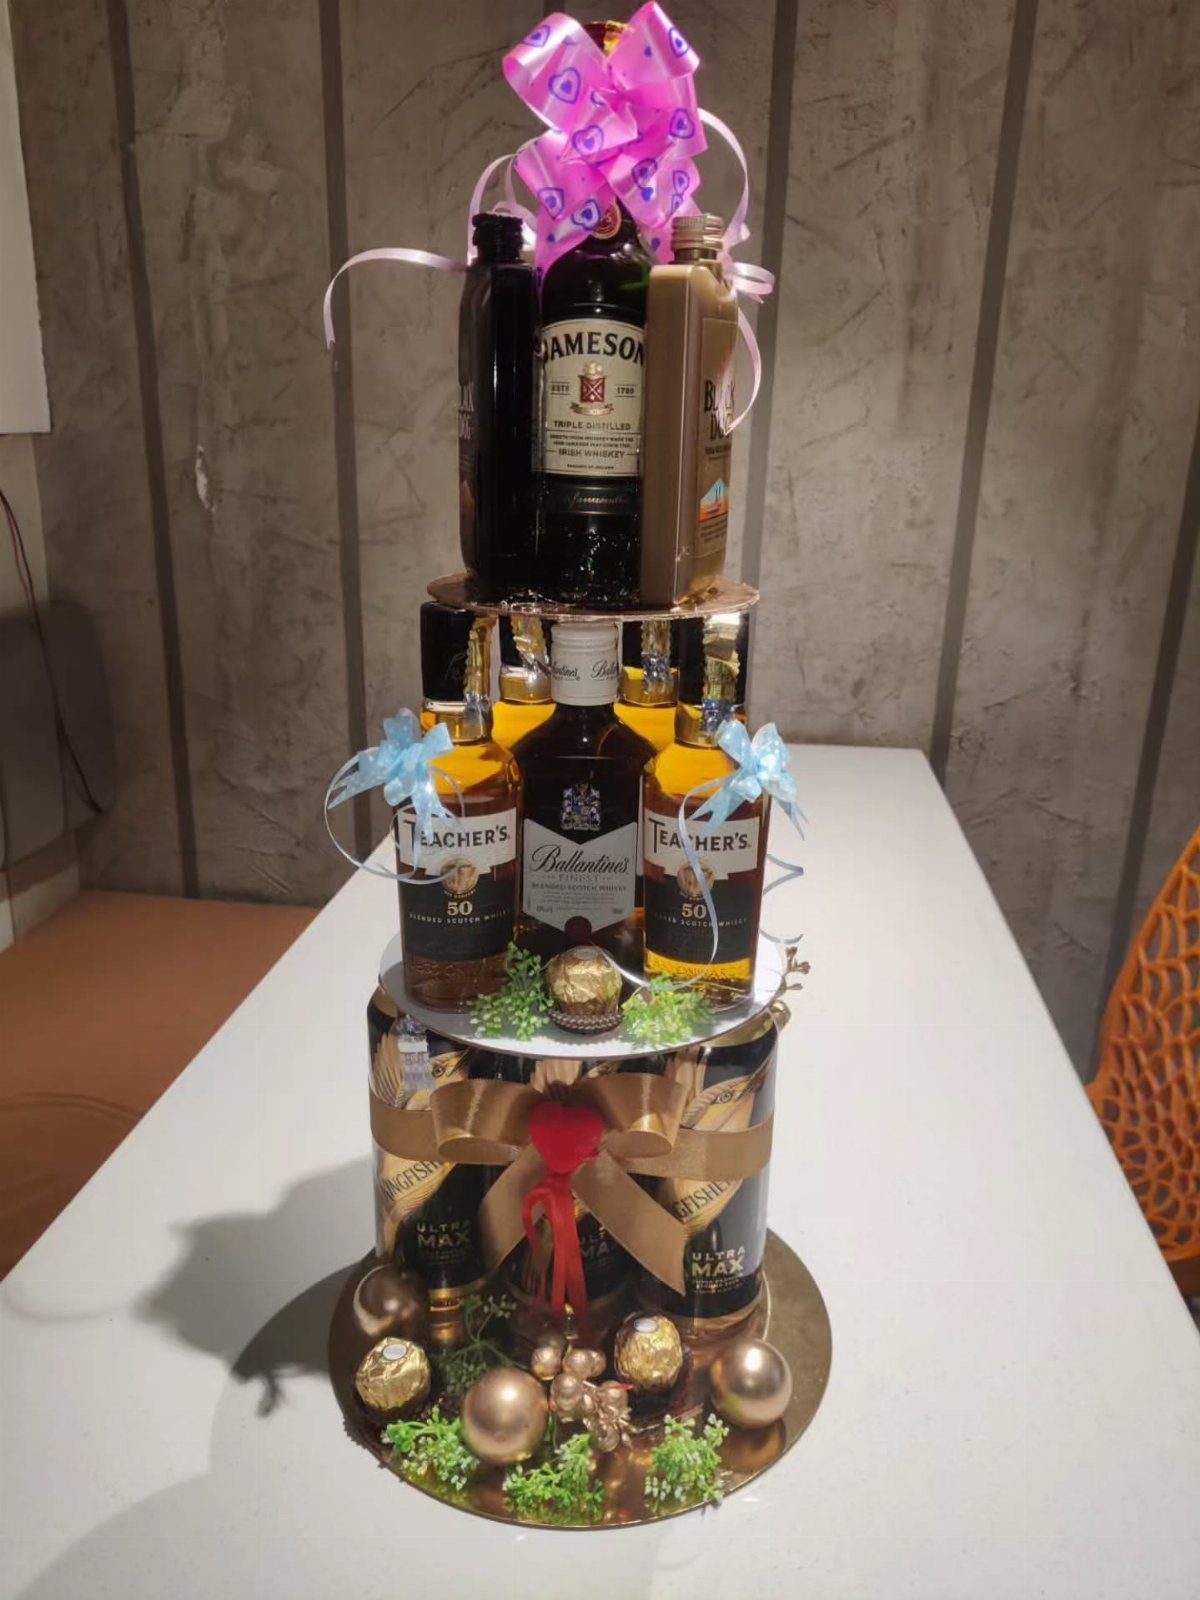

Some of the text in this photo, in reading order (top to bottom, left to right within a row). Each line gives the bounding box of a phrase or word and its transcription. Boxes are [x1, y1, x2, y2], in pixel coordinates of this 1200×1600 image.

[554, 421, 631, 430] TRIPLE DISTILLED
[585, 450, 625, 458] WHISKEY
[649, 818, 748, 853] TEAHER'S
[447, 901, 473, 916] 50
[682, 903, 707, 919] 50
[417, 1230, 470, 1249] MAX
[692, 1246, 745, 1261] ULTRA
[692, 1257, 744, 1277] MAX
